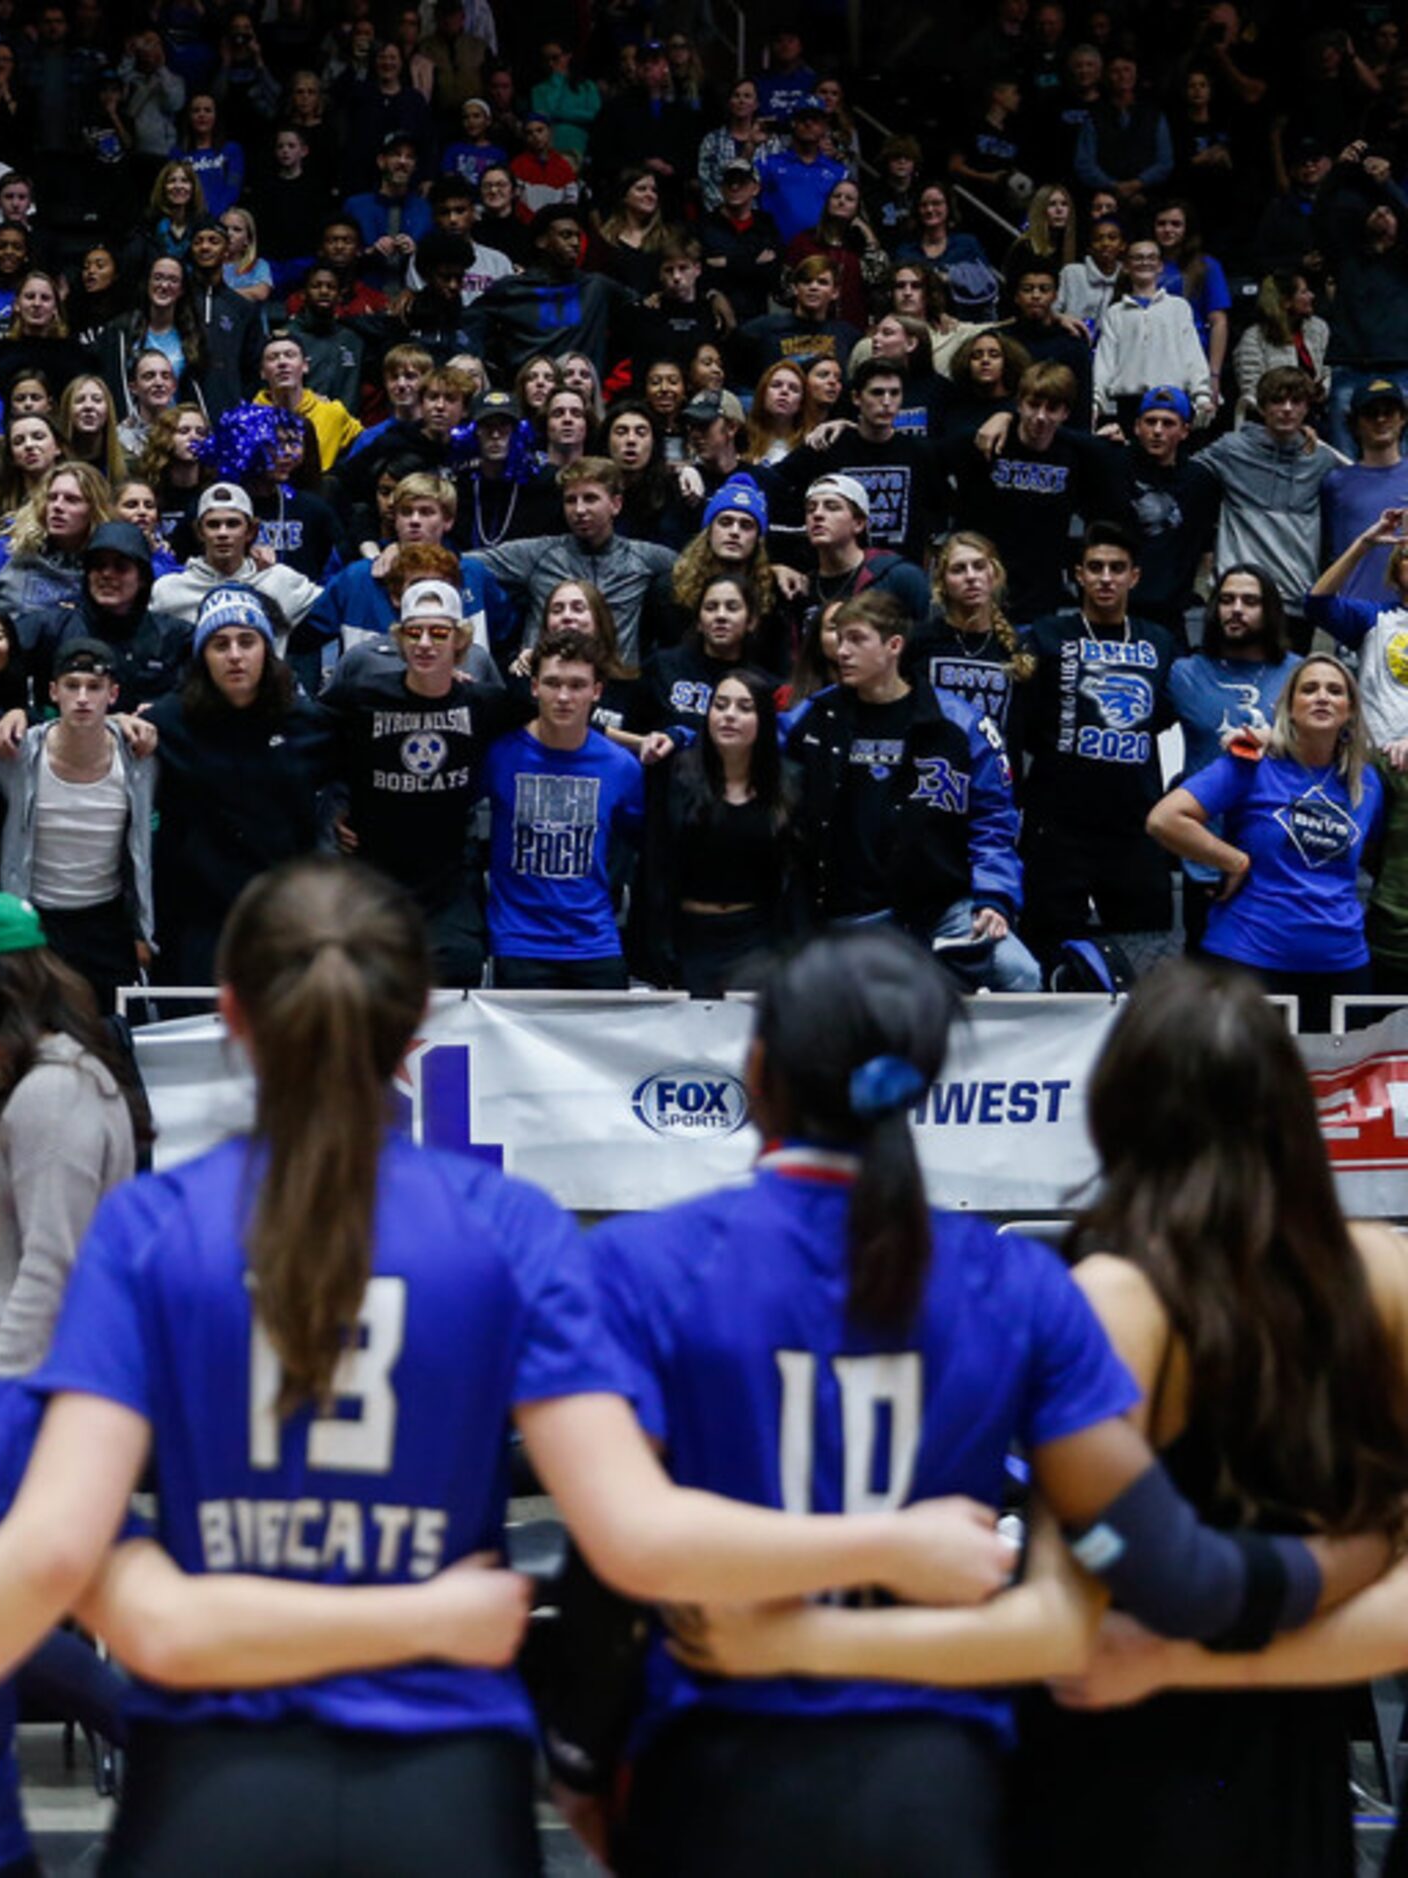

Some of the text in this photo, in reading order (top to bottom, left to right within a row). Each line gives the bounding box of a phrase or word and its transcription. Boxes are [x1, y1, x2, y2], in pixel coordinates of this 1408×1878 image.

[868, 493, 904, 510] LAY
[940, 664, 1007, 690] BNVB
[373, 706, 472, 738] BYRON NELSON
[1077, 726, 1152, 764] 2020
[373, 766, 470, 793] BOBCATS
[657, 1082, 730, 1113] FOX
[915, 1079, 1071, 1125] WEST
[657, 1114, 730, 1128] SPORTS
[248, 1275, 407, 1474] 13
